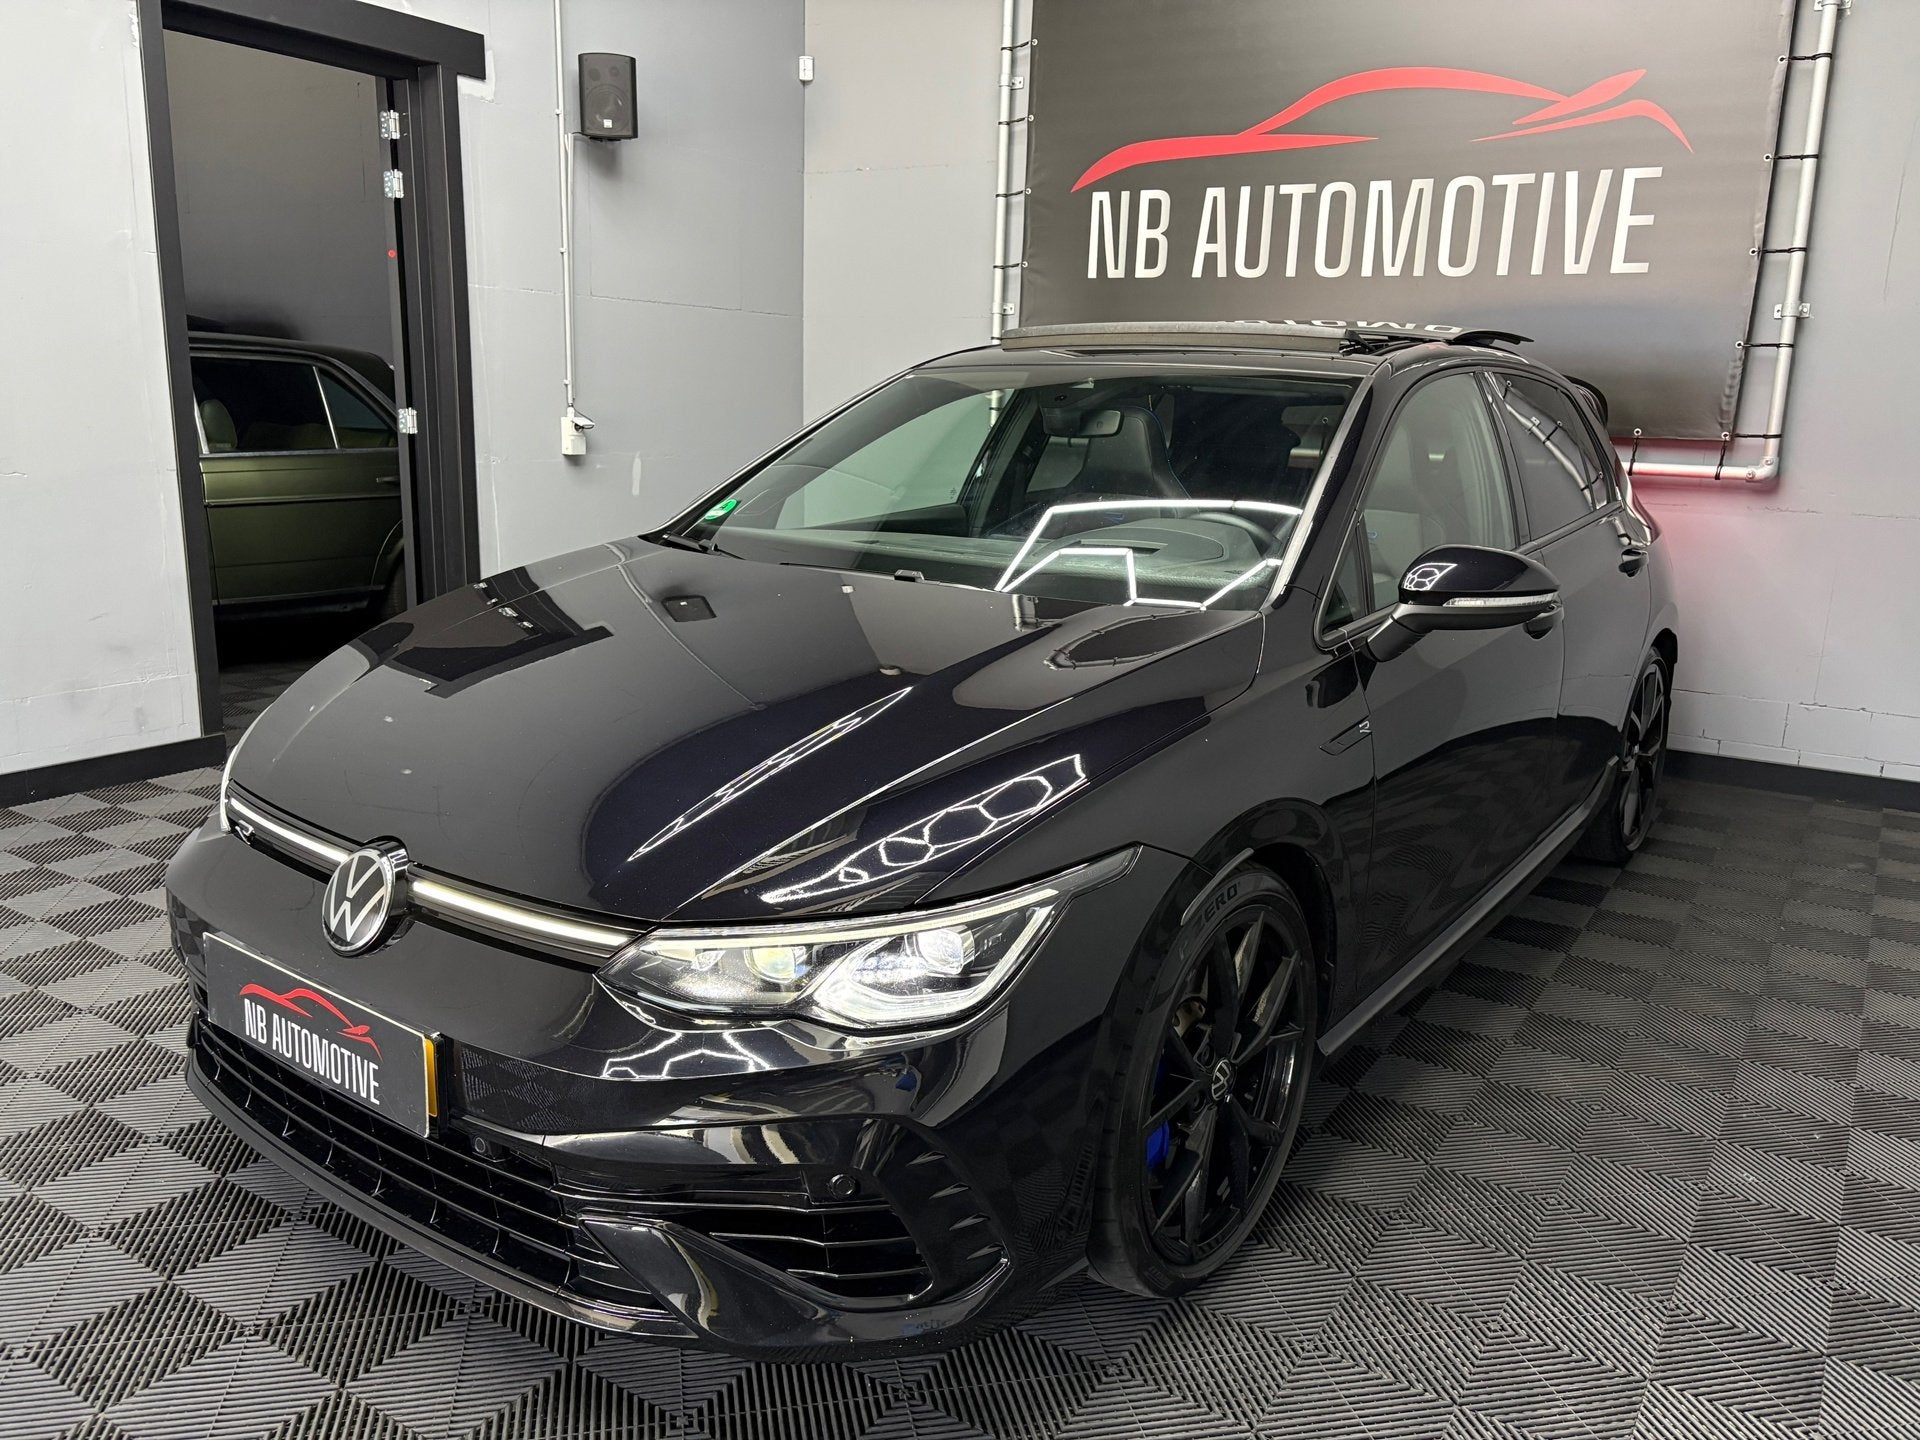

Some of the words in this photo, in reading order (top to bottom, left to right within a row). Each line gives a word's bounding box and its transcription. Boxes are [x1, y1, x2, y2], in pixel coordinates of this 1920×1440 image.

[1087, 189, 1171, 279] NB
[1191, 166, 1664, 278] AUTOMOTIVE
[326, 851, 388, 946] VW
[243, 997, 268, 1045] NB
[271, 1012, 381, 1106] AUTOMOTIVE
